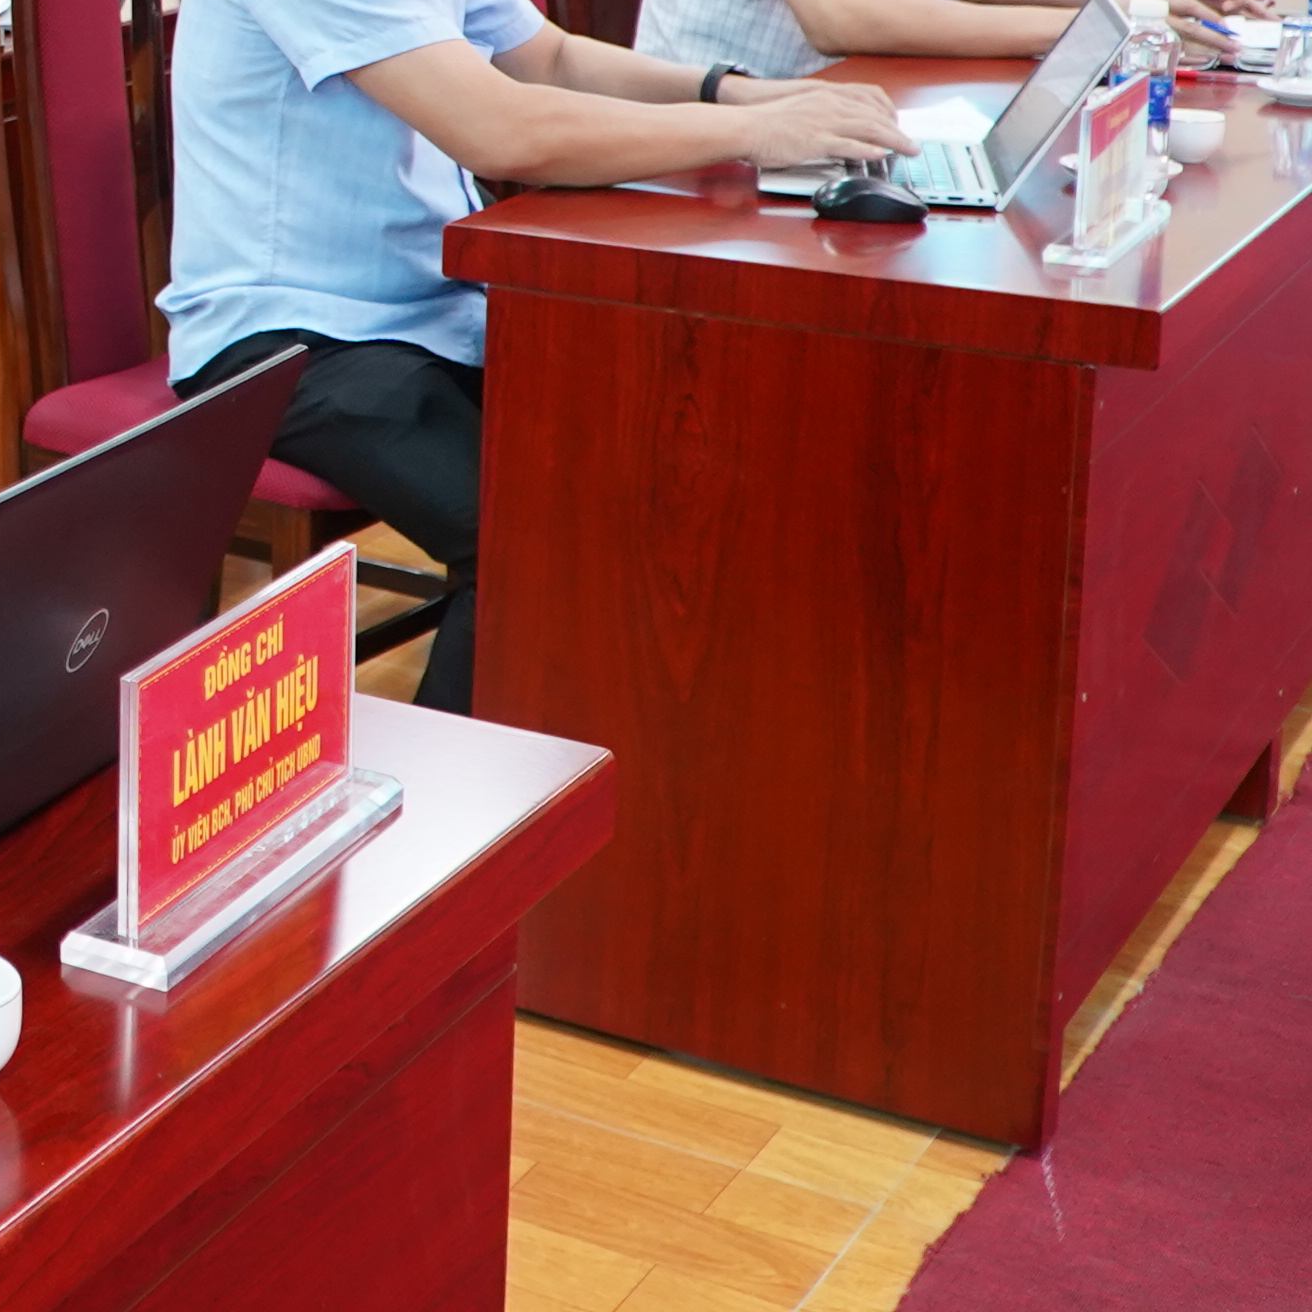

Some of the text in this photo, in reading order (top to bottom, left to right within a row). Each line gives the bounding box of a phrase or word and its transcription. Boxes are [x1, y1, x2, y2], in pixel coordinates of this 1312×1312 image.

[204, 613, 284, 701] ĐỒNG CHÍ
[173, 654, 319, 808] LÀNH VĂN HIỆU
[172, 825, 187, 864] ỦY
[188, 814, 211, 854] VIÊN
[234, 776, 255, 820] PHÓ
[256, 756, 275, 804] CHỦ
[276, 751, 296, 791] TỊCH
[297, 733, 321, 773] UBND
